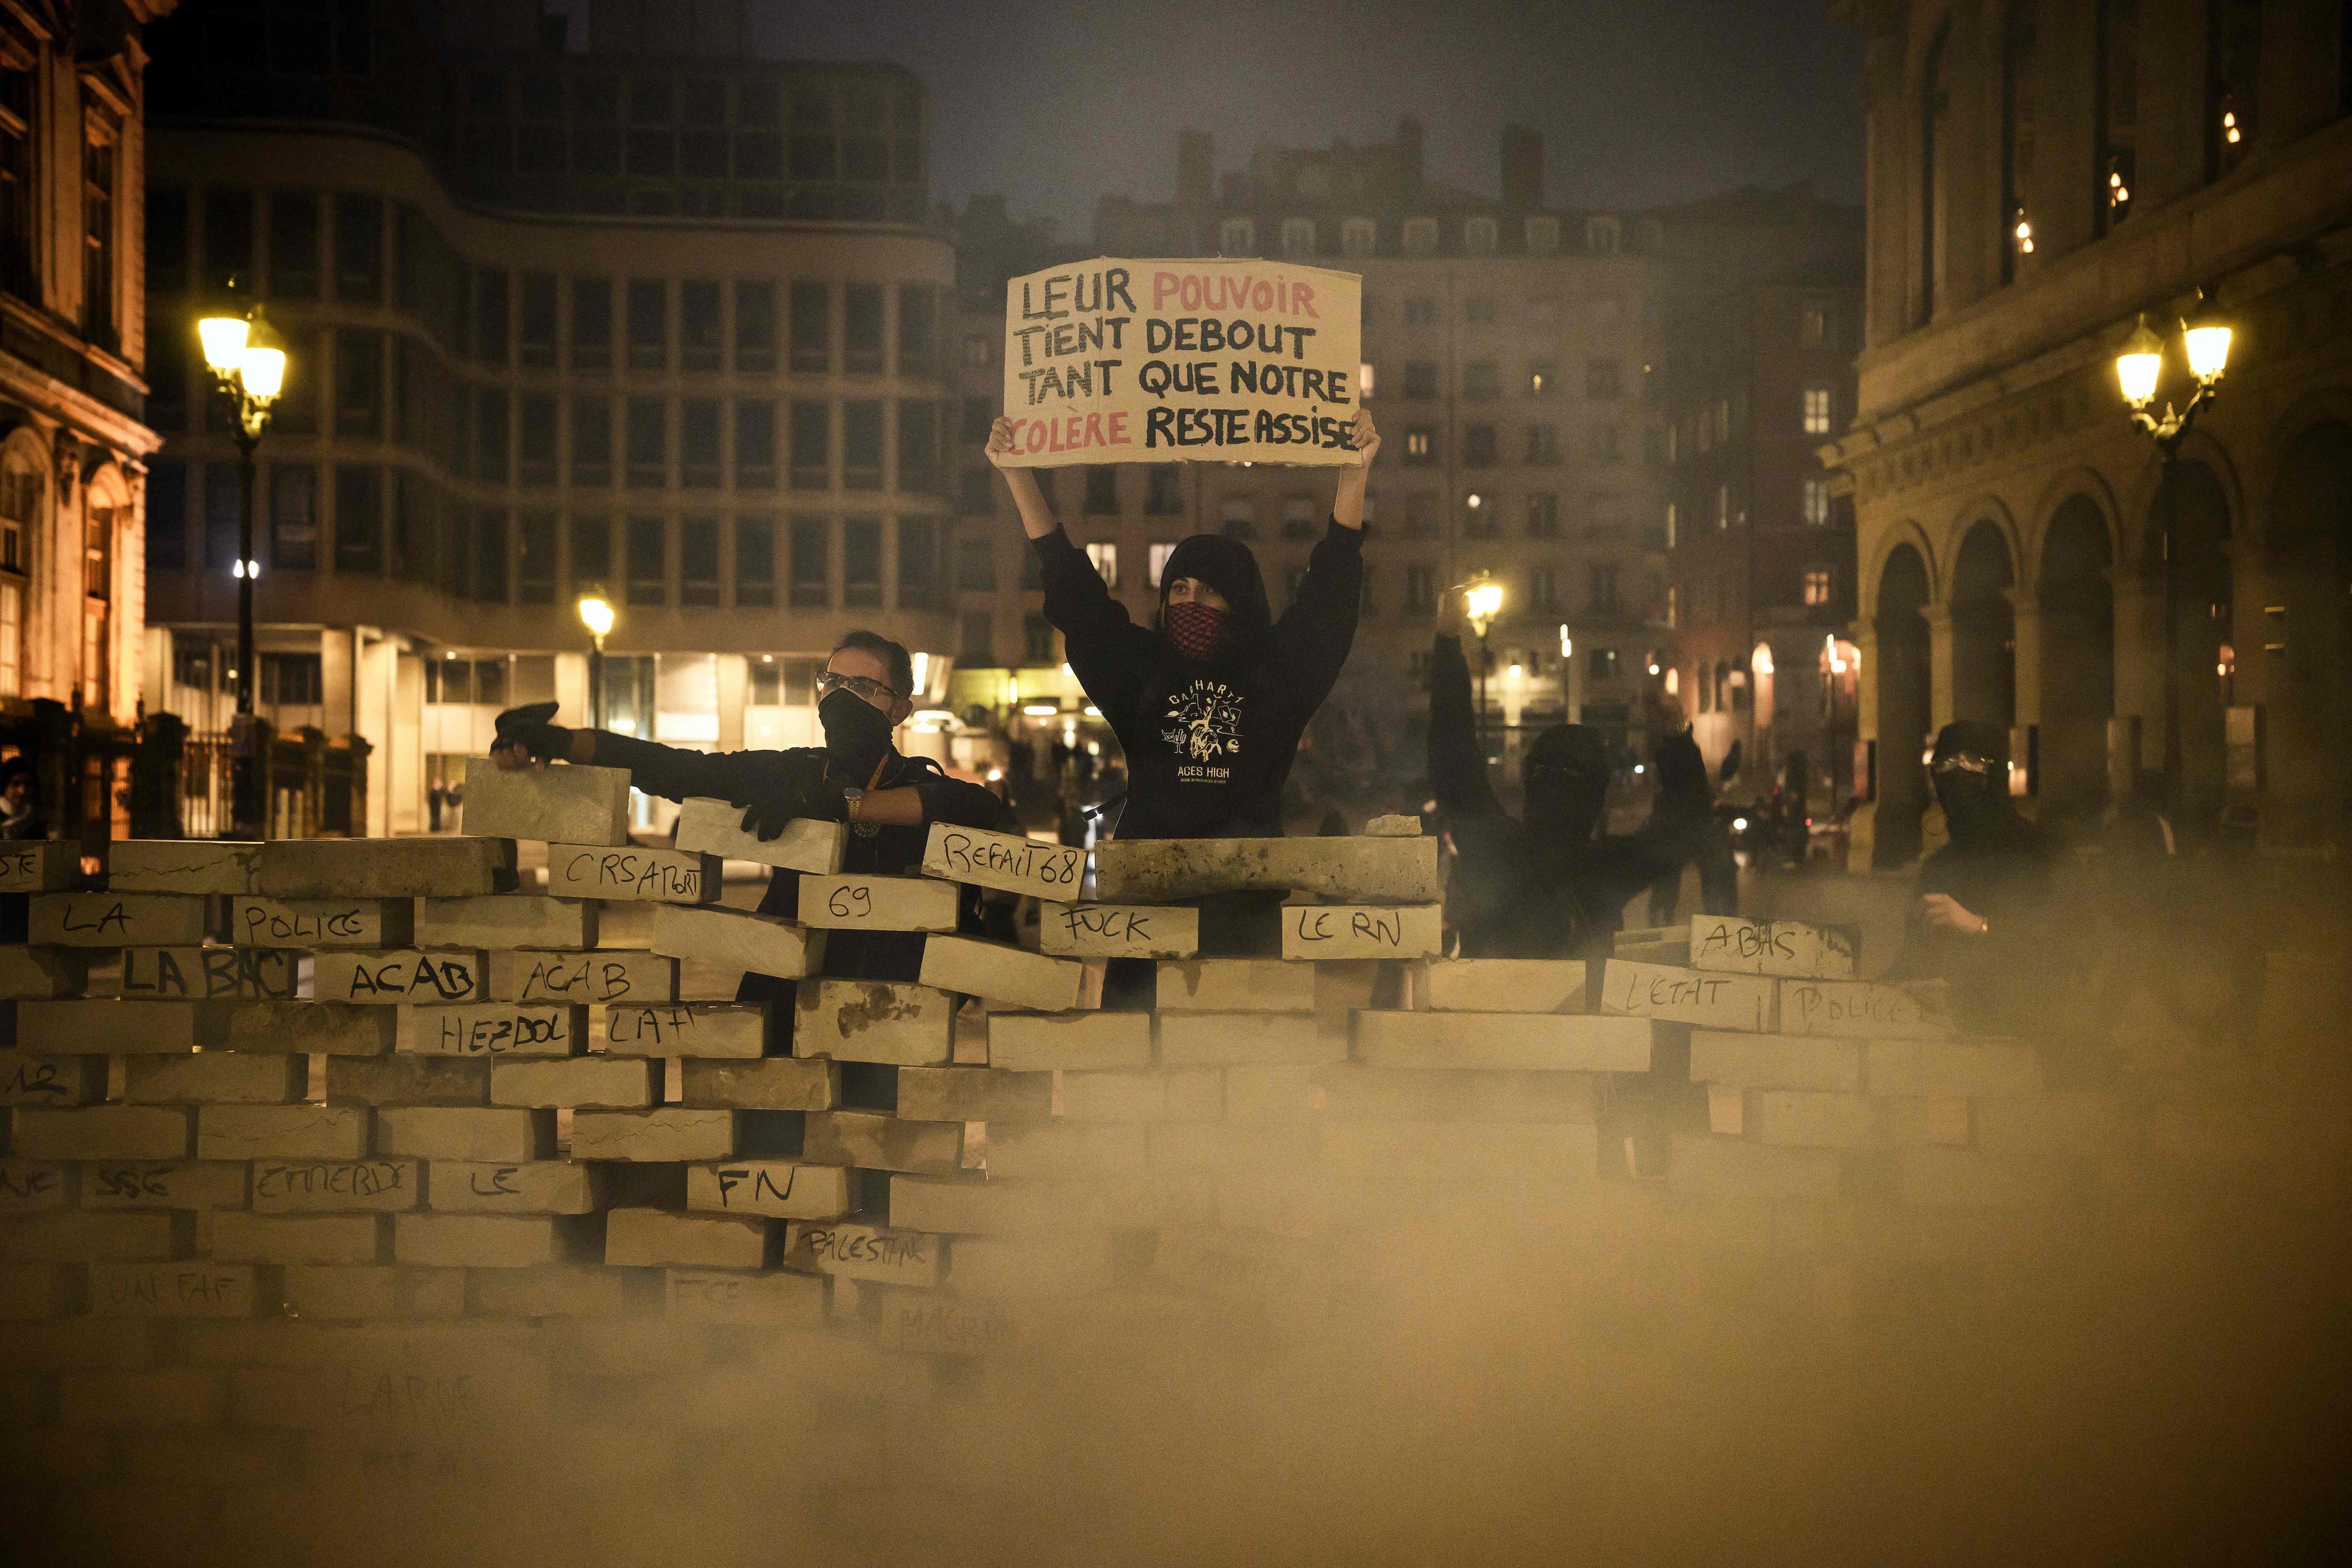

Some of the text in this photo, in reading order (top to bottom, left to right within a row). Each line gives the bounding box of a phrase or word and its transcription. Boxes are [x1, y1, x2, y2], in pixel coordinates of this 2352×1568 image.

[1022, 268, 1137, 320] LEUR
[1146, 318, 1317, 360] DEBOUT
[1018, 359, 1351, 406] TANT QUE NOTRE
[1010, 406, 1132, 456] COLÈRE
[1145, 406, 1250, 448] RESTE
[1177, 766, 1229, 778] ACES HIGH
[1041, 850, 1078, 884] 68
[63, 902, 133, 933] LA
[829, 886, 872, 917] 69
[245, 907, 363, 943] POLICE
[1060, 907, 1152, 941] FUCK
[1298, 909, 1401, 947] LE RN
[124, 948, 290, 999] LA BAC
[350, 955, 475, 1000] ACAB
[522, 960, 631, 1001] ACAB
[471, 1167, 521, 1196] LE
[718, 1166, 795, 1208] FN
